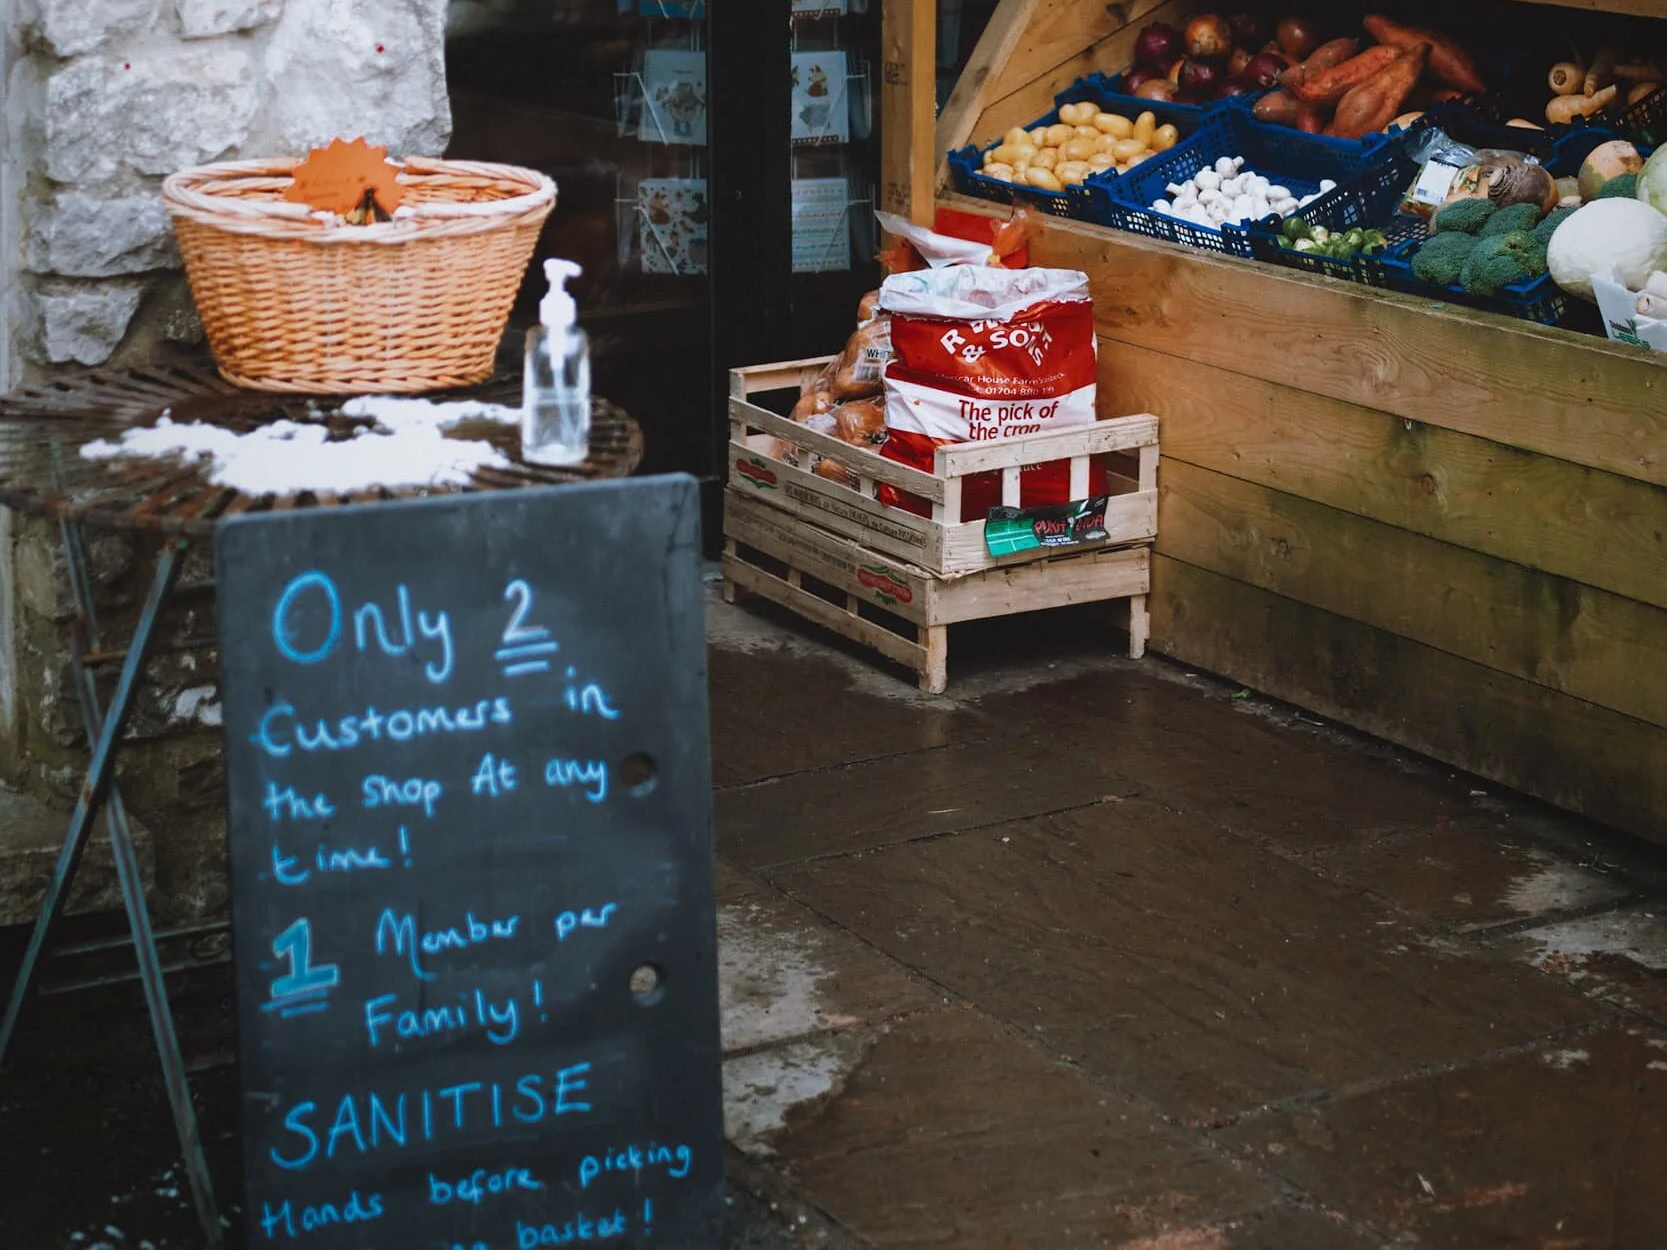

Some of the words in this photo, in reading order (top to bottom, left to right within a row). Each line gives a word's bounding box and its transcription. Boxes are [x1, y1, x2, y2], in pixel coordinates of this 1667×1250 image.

[940, 329, 966, 356] R
[961, 344, 987, 364] &
[958, 399, 992, 421] The
[997, 403, 1034, 426] pick
[1039, 401, 1060, 419] of
[977, 375, 1010, 385] House
[969, 422, 999, 440] the
[272, 570, 455, 684] Only
[502, 579, 548, 641] 2
[250, 695, 512, 756] Customers
[564, 666, 622, 719] in
[264, 781, 336, 822] the
[362, 774, 442, 818] shop
[471, 752, 517, 793] At
[545, 756, 611, 804] any
[270, 826, 415, 884] time!
[270, 917, 338, 998] 1
[555, 901, 618, 941] per
[363, 979, 547, 1045] Family!
[270, 1061, 592, 1169] SANITISE
[260, 1190, 384, 1238] Hands
[428, 1166, 543, 1204] before
[579, 1143, 693, 1188] picking
